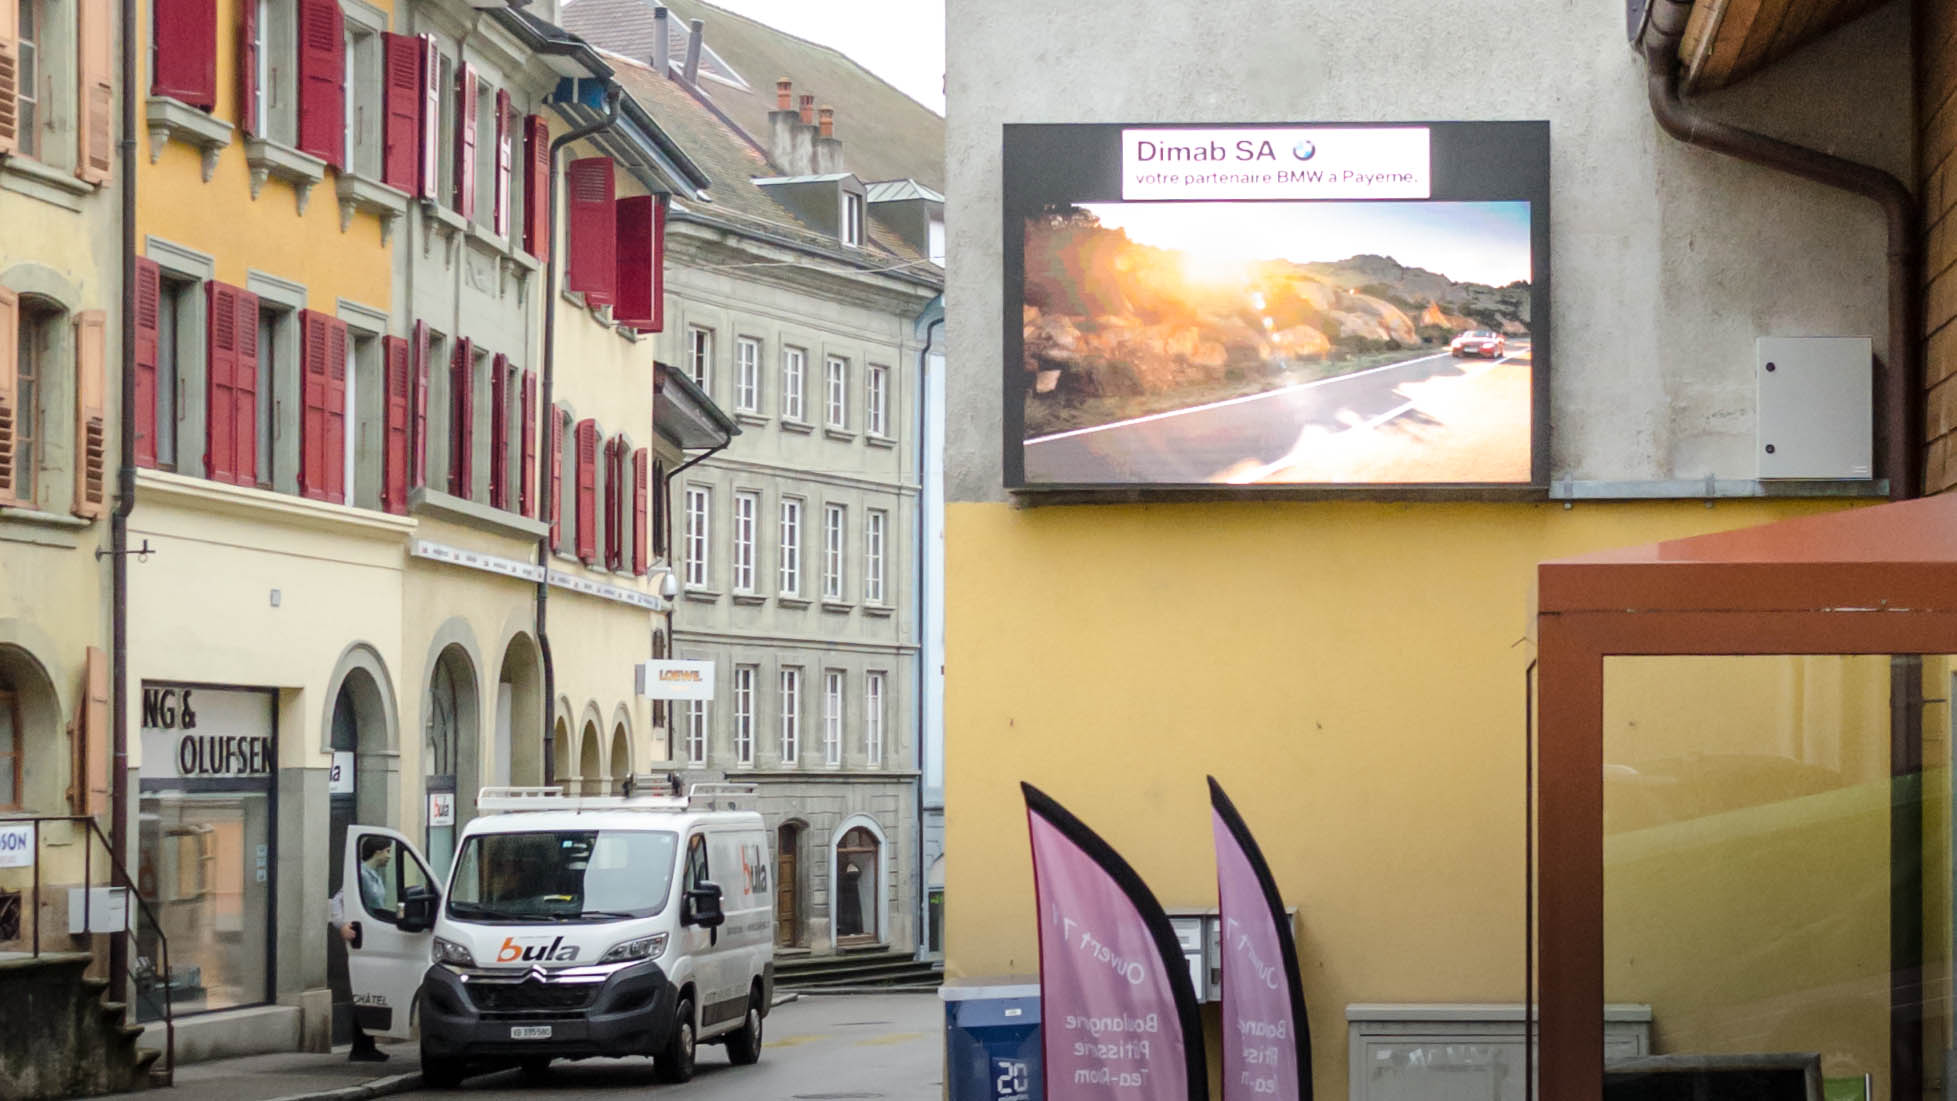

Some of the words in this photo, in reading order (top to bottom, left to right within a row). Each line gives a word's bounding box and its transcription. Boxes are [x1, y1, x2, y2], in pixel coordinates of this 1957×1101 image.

[1137, 140, 1226, 161] Dimab
[1235, 140, 1276, 161] SA
[1136, 173, 1180, 184] votre
[1184, 173, 1272, 186] partenaire
[1277, 170, 1323, 183] BMW
[181, 689, 196, 729] &
[180, 735, 274, 774] OLUFSEN
[496, 936, 580, 963] bula
